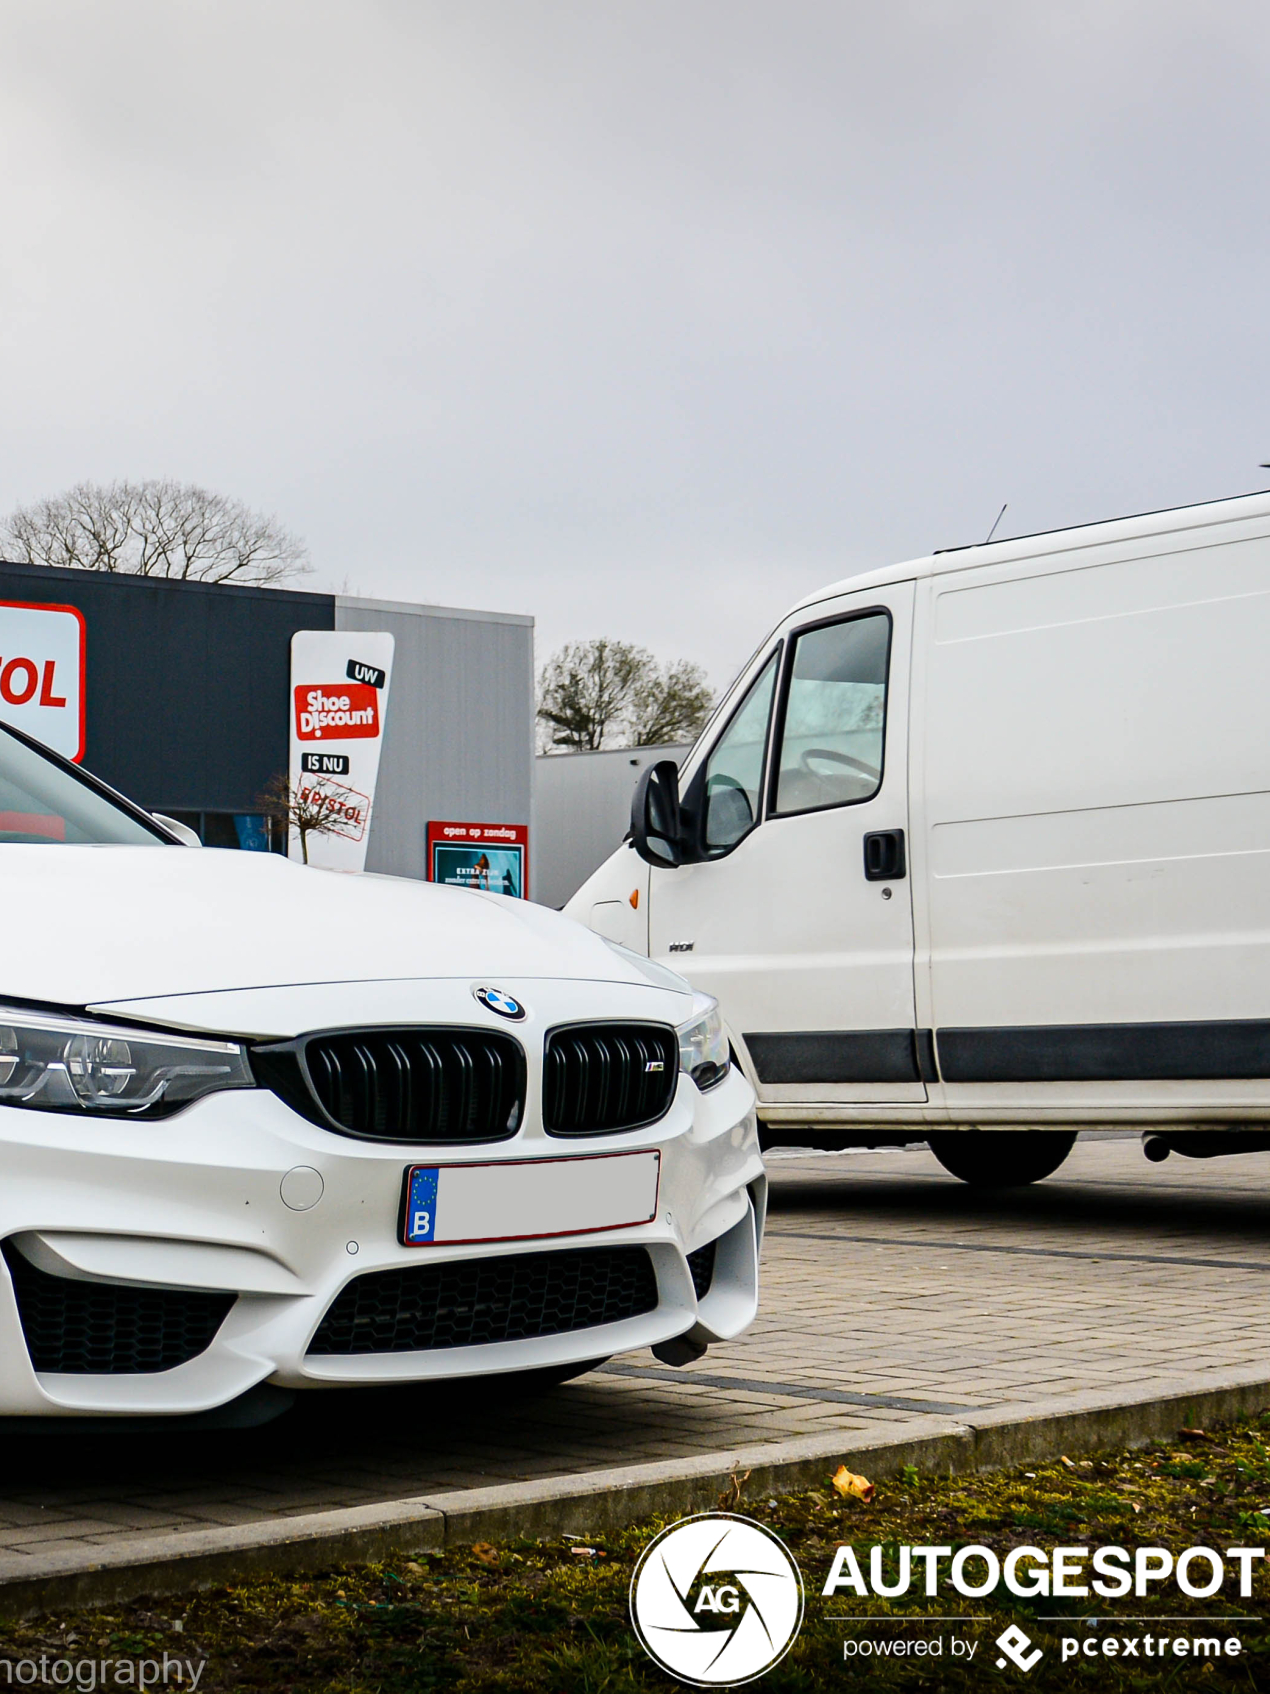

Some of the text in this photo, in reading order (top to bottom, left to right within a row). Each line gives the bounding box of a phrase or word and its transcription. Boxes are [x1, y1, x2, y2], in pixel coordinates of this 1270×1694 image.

[355, 665, 378, 684] UW
[307, 690, 350, 711] Shoe
[308, 756, 343, 772] IS NU
[443, 827, 516, 840] open op zondag
[413, 1211, 430, 1235] B
